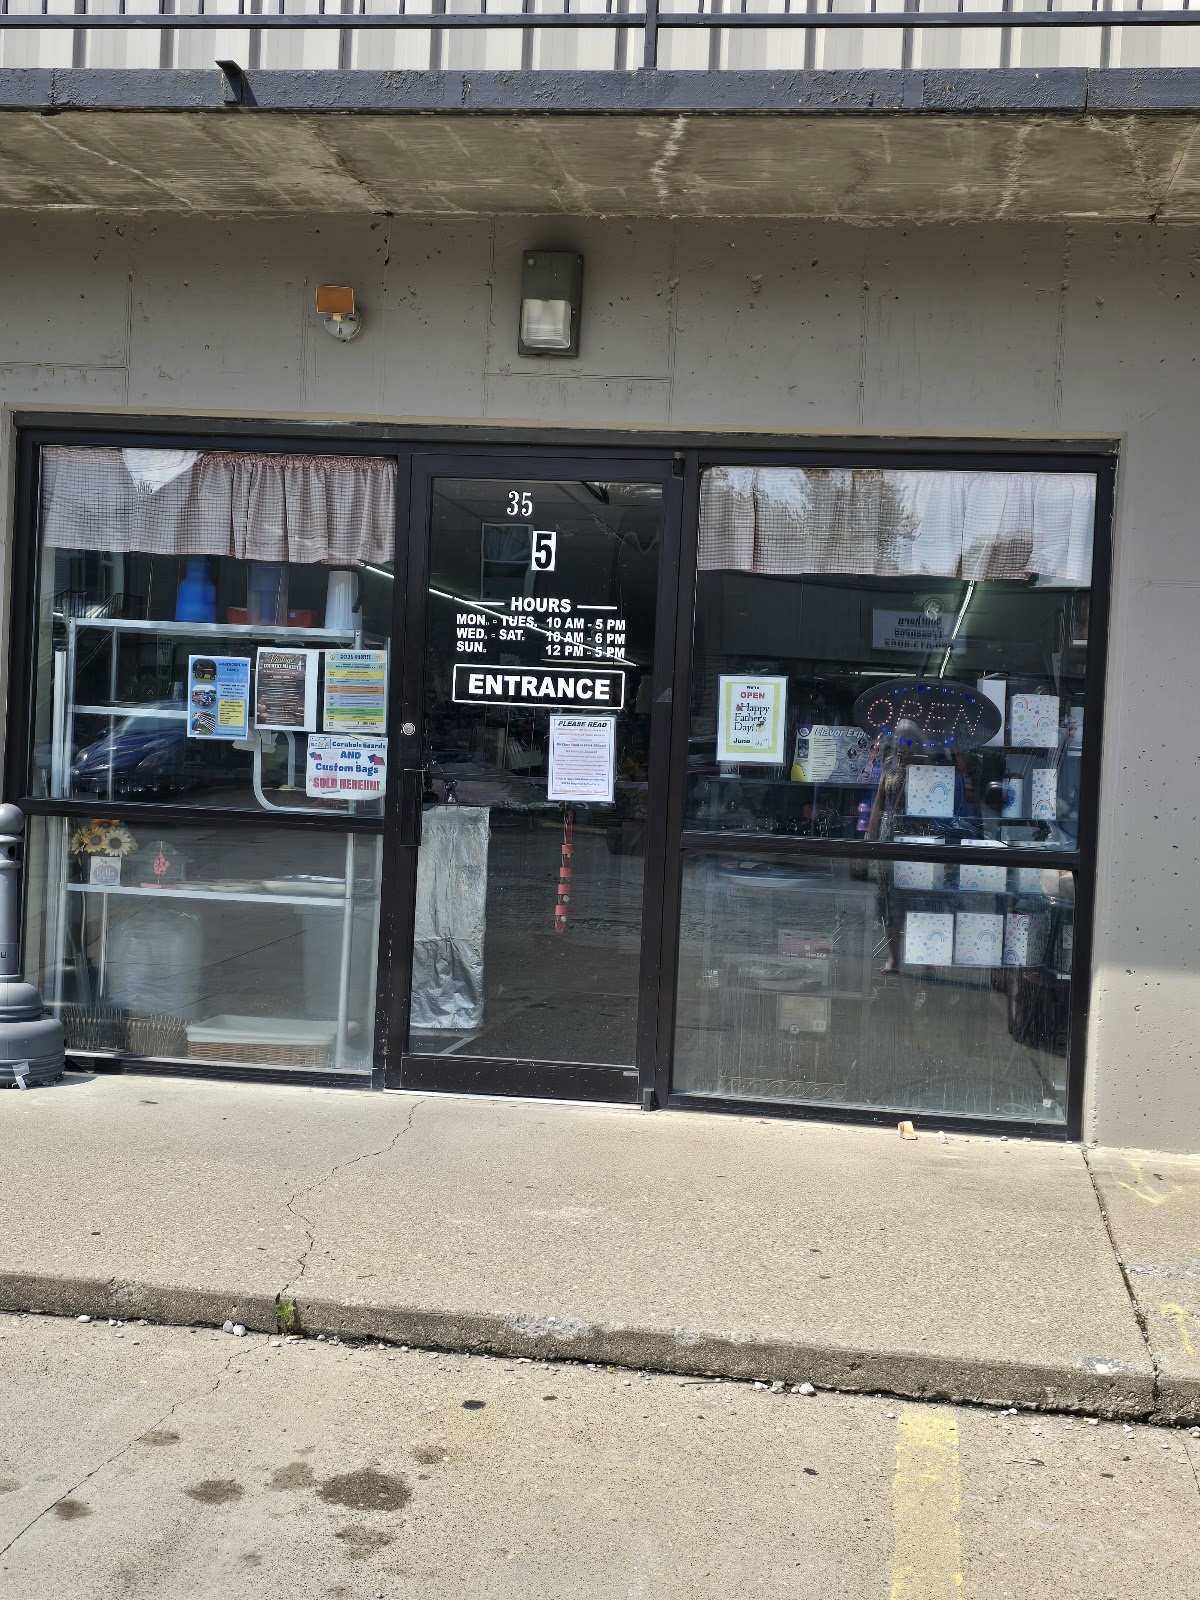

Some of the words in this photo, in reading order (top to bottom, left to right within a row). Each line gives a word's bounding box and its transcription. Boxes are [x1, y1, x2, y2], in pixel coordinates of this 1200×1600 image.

[506, 491, 533, 516] 35
[535, 533, 552, 569] 5
[511, 597, 571, 612] HOURS
[456, 614, 489, 626] MON.
[501, 616, 538, 627] TUES.
[546, 617, 561, 628] 10
[565, 618, 584, 629] AM
[596, 619, 604, 629] 5
[607, 620, 626, 630] PM
[457, 629, 488, 639] WED.
[499, 629, 525, 640] SAT.
[546, 632, 561, 642] 10
[564, 632, 584, 643] AM
[595, 633, 603, 644] 6
[607, 634, 625, 644] PM
[457, 641, 486, 653] SUN.
[546, 645, 560, 656] 12
[565, 646, 584, 657] PM
[595, 647, 603, 657] 5
[606, 647, 625, 658] PM
[468, 674, 610, 700] ENTRANCE
[741, 703, 770, 716] Happy
[734, 713, 766, 722] Father's
[868, 699, 984, 736] OPEN
[815, 728, 846, 737] Flavor
[340, 751, 361, 759] AND
[315, 763, 353, 772] Custom
[356, 765, 378, 776] Bags
[313, 778, 337, 788] SOLD
